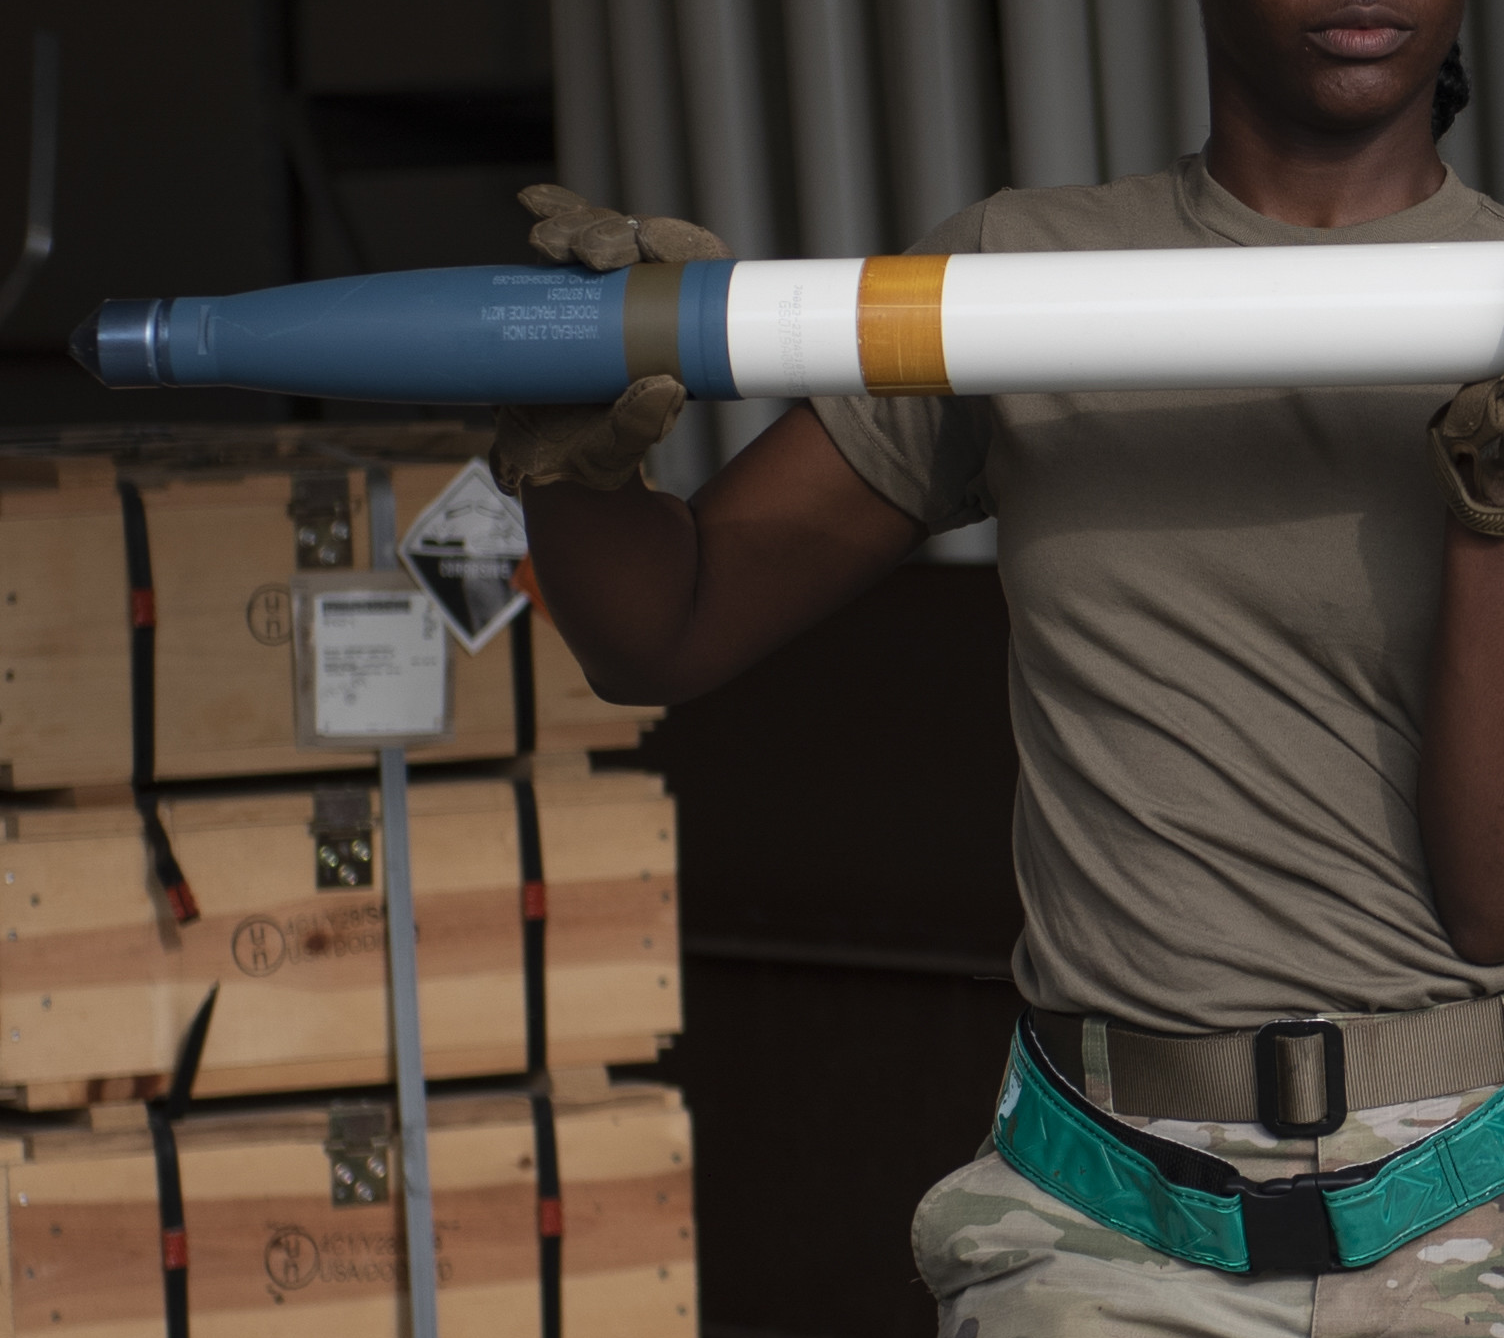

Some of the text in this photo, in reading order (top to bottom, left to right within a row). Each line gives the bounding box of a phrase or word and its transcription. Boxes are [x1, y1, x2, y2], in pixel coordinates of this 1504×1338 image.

[480, 304, 506, 321] M274
[559, 304, 600, 320] ROCKET,
[502, 322, 600, 340] WARHEAD, 2.75 INCH
